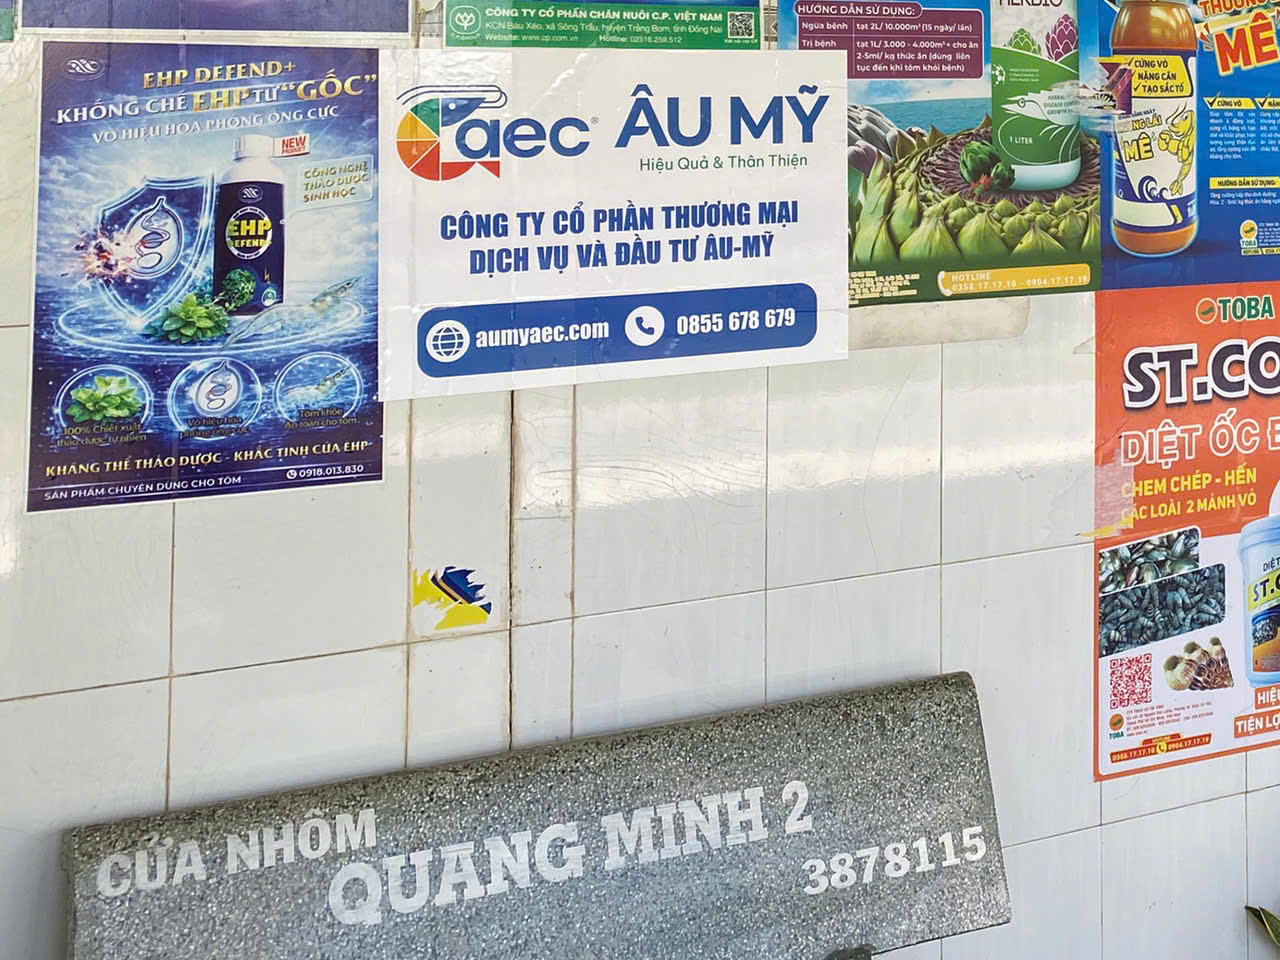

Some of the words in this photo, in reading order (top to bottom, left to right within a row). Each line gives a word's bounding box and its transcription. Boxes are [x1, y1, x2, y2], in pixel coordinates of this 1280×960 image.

[700, 12, 722, 21] NAM
[798, 3, 837, 14] HƯỚNG
[1214, 11, 1280, 76] MÊ
[143, 71, 189, 89] EHP
[195, 60, 296, 83] DEFEND+
[1138, 70, 1158, 82] NẶNG
[1161, 70, 1176, 80] CÂN
[57, 99, 139, 124] KHỐNG
[192, 86, 250, 113] EHP
[615, 83, 712, 148] ÂU
[730, 83, 830, 145] MỸ
[281, 136, 306, 149] NEW
[454, 117, 591, 160] aec
[1015, 136, 1033, 145] LITER
[639, 155, 673, 174] Hiệu
[678, 154, 709, 171] Quả
[728, 154, 764, 169] Thân
[768, 153, 808, 172] Thiện
[304, 191, 330, 203] SINH
[440, 209, 509, 240] CÔNG
[517, 211, 545, 236] TY
[552, 201, 584, 234] CỔ
[594, 199, 654, 233] PHẦN
[662, 200, 750, 230] THƯƠNG
[758, 200, 798, 228] MẠI
[470, 247, 529, 278] DỊCH
[537, 246, 568, 274] VỤ
[577, 240, 608, 268] VÀ
[614, 234, 661, 265] ĐẦU
[669, 235, 700, 263] TƯ
[704, 230, 775, 261] ÂU-MỸ
[952, 272, 991, 282] HOTLINE
[1218, 295, 1275, 322] TOBA
[475, 320, 610, 350] aumyaec.com
[676, 311, 723, 336] 0855
[728, 309, 761, 332] 678
[764, 307, 796, 329] 679
[1121, 419, 1201, 469] DIỆT
[1209, 408, 1260, 456] ỐC
[192, 477, 215, 488] CHO
[299, 464, 364, 478] 0918.013.830
[1170, 469, 1212, 493] CHÉP
[1109, 731, 1124, 740] TOBA
[96, 840, 206, 899] CỬA
[225, 807, 378, 874] NHÔM
[327, 821, 583, 927] QUANG
[600, 786, 764, 873] MINH
[781, 779, 813, 836] 2
[800, 827, 987, 897] 3878115
